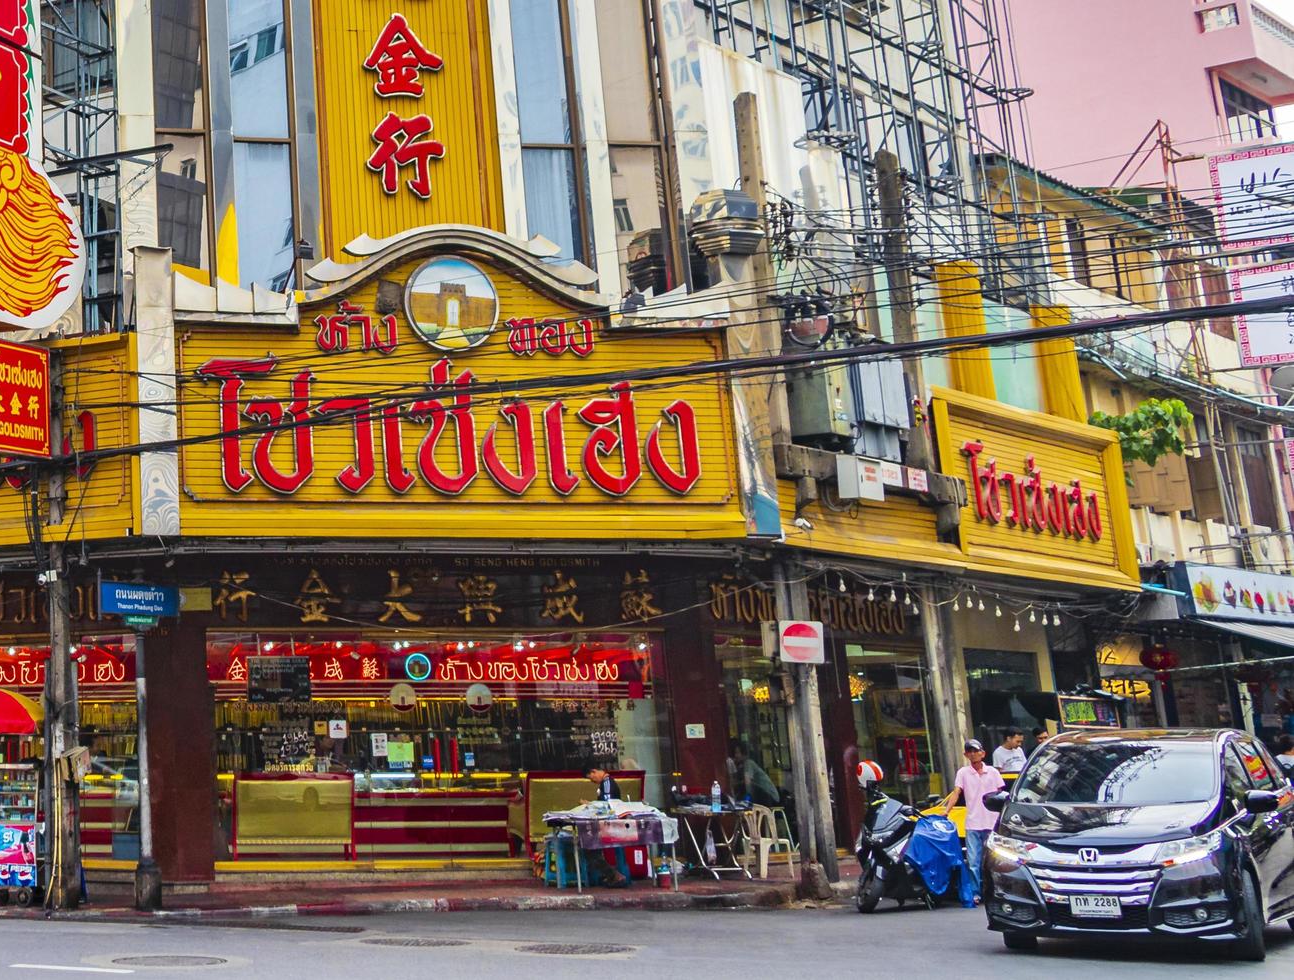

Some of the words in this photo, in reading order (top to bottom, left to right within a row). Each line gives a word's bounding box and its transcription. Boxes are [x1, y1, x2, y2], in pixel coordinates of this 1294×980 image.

[362, 12, 446, 199] 金行
[314, 300, 398, 354] ห้าง
[505, 315, 596, 359] ทอง
[196, 350, 703, 498] โซวเซ่งเฮง
[474, 557, 502, 568] SENG
[506, 557, 535, 568] HENG
[117, 602, 134, 611] Thanon
[1093, 897, 1118, 907] 2288
